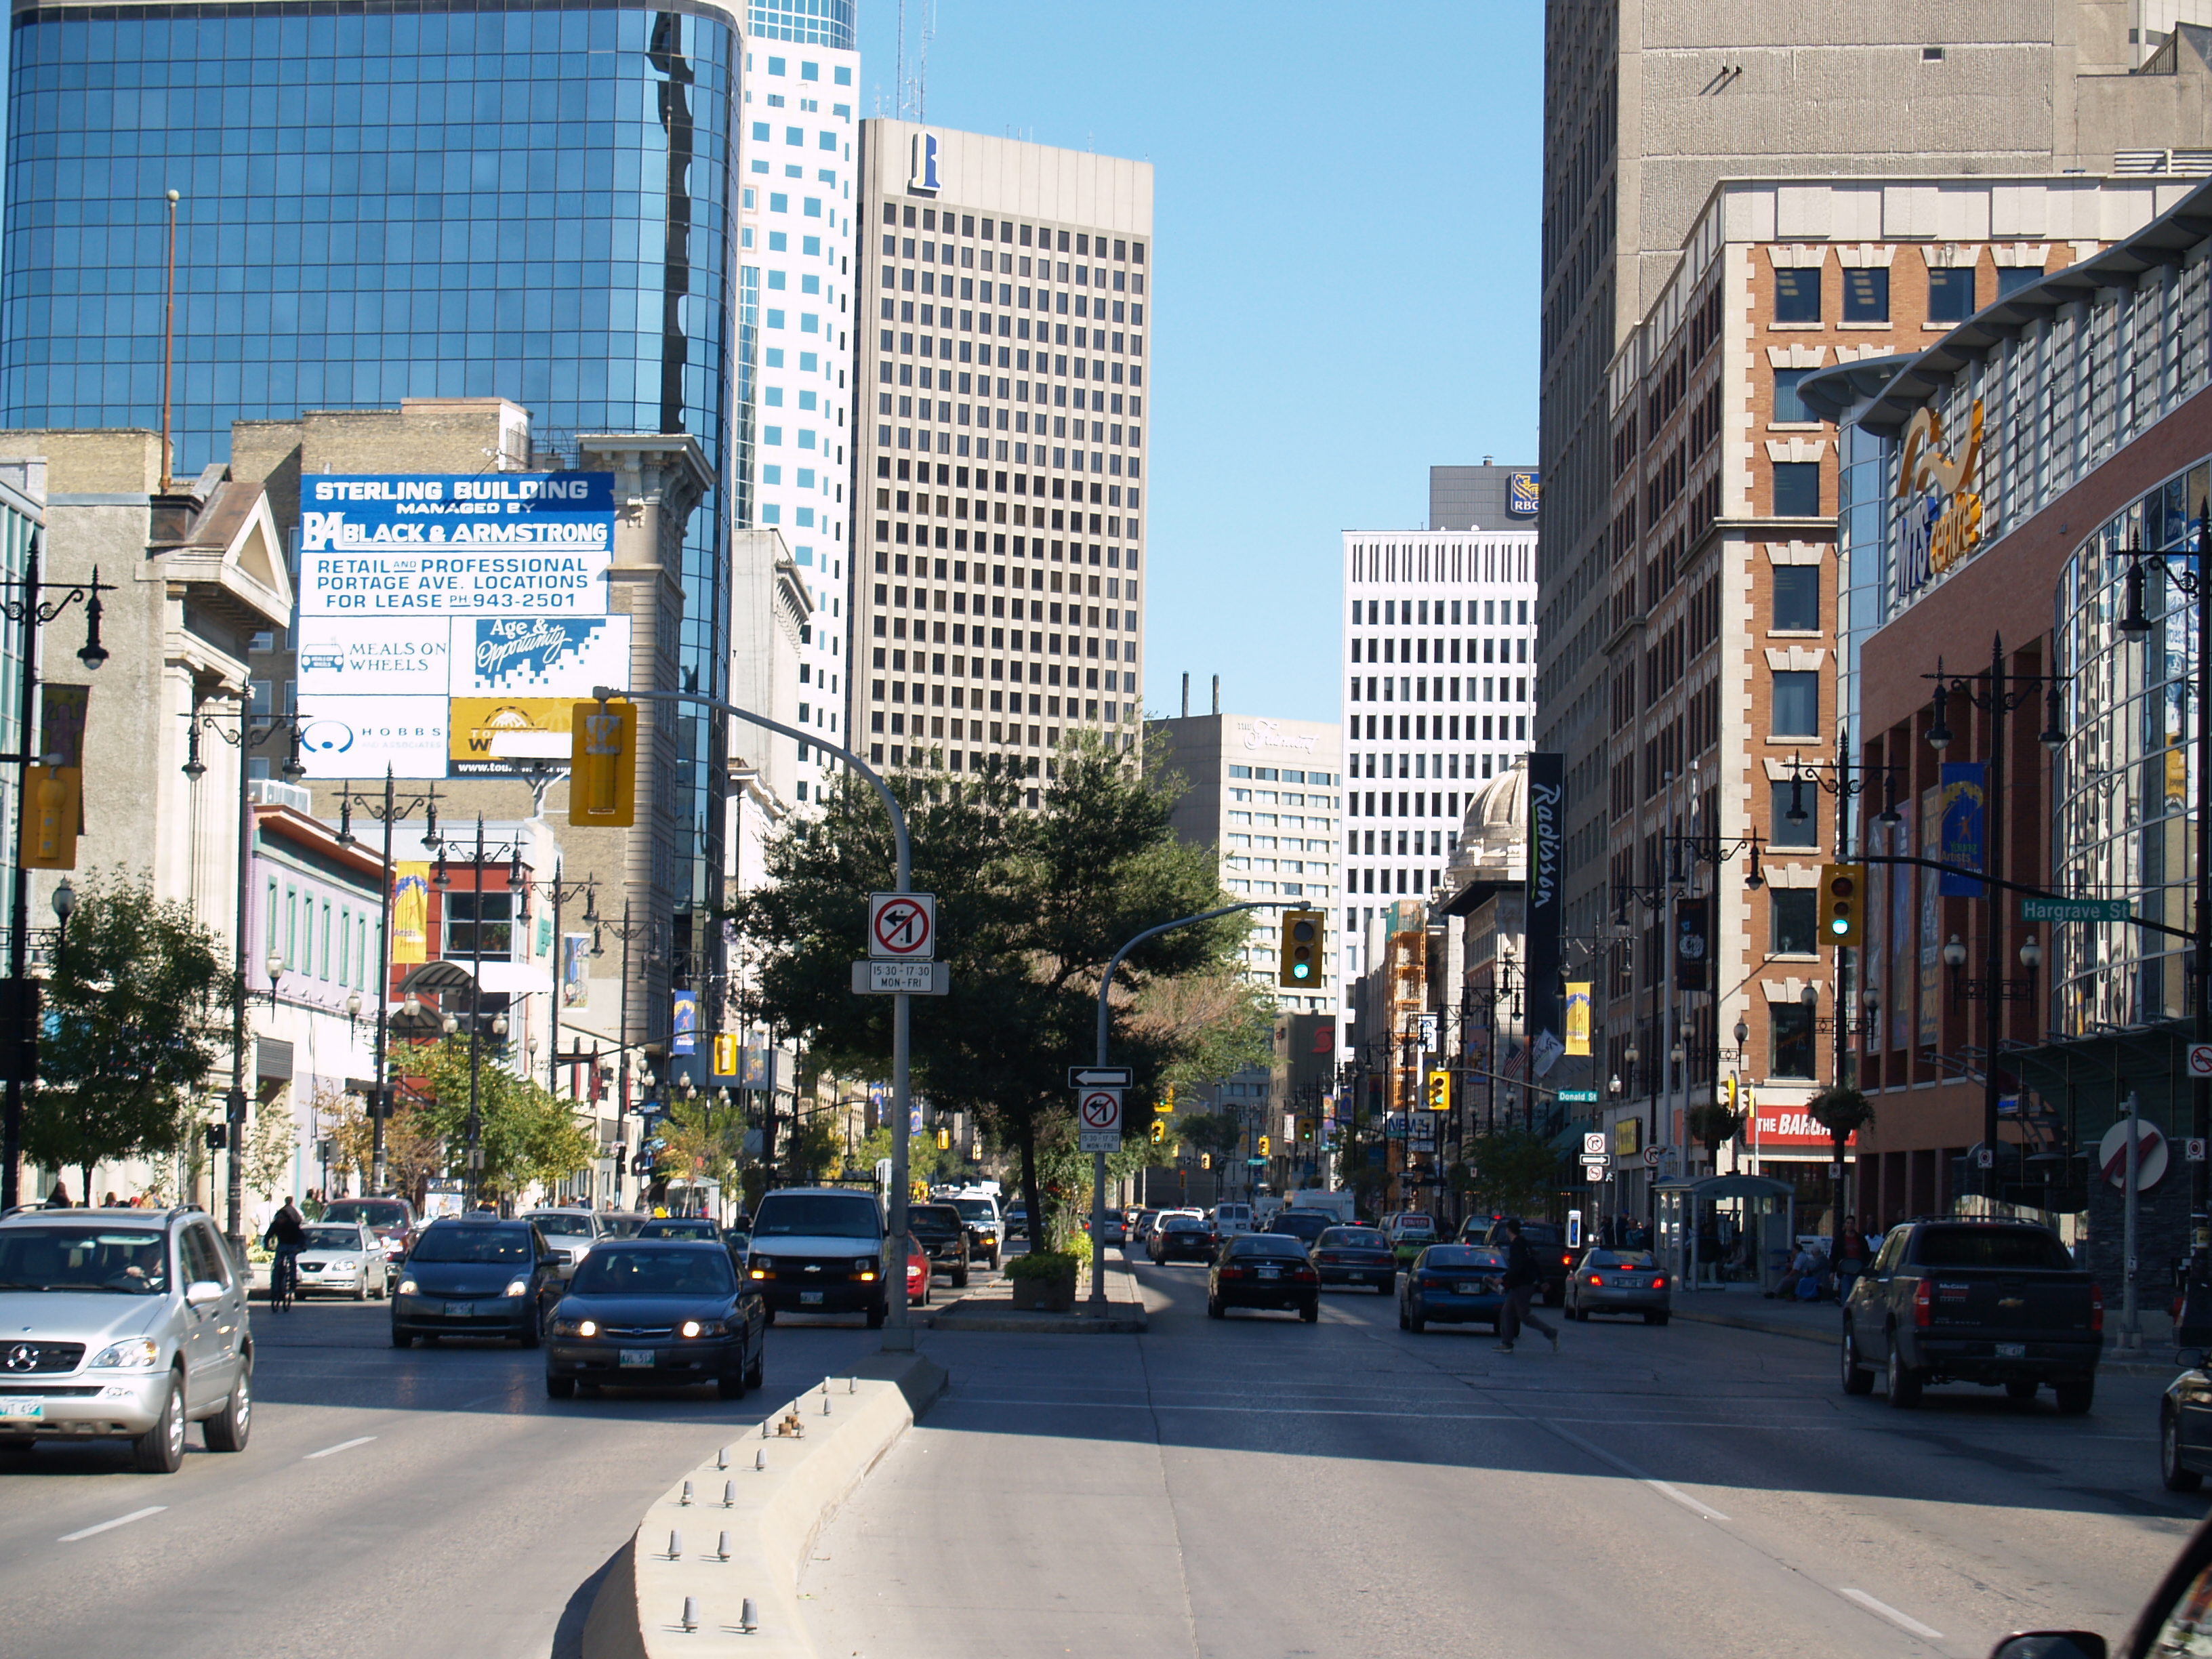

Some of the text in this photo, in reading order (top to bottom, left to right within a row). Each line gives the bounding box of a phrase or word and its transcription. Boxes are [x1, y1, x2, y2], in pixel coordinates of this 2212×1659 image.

[316, 480, 588, 500] STERLING BUILDING
[396, 503, 535, 514] MANAGED BY
[1515, 501, 1539, 510] RBC
[343, 523, 607, 543] BLACK & ARMSTRONG
[1897, 492, 1973, 596] MTS centre
[319, 559, 391, 573] RETAIL
[421, 558, 588, 573] PROFESSIONAL
[318, 575, 588, 590] PORTAGE AVE. LOCATIONS
[327, 595, 366, 608] FOR
[376, 594, 442, 608] LEASE
[474, 593, 574, 607] 943-2501
[490, 617, 548, 639] Age &
[350, 642, 447, 655] MEALS ON
[477, 624, 573, 673] Opportunity
[350, 659, 428, 671] WHEELS
[363, 728, 441, 737] HOBBS
[1244, 718, 1319, 755] Fairmont
[1530, 783, 1561, 909] Radisson
[1941, 851, 1971, 863] Artists
[2024, 902, 2128, 921] Hargrave St
[874, 966, 897, 975] 15:30
[906, 966, 929, 976] 17:30
[881, 978, 922, 987] MON-FRI
[1559, 1092, 1597, 1101] Donald St
[1757, 1118, 1776, 1132] THE
